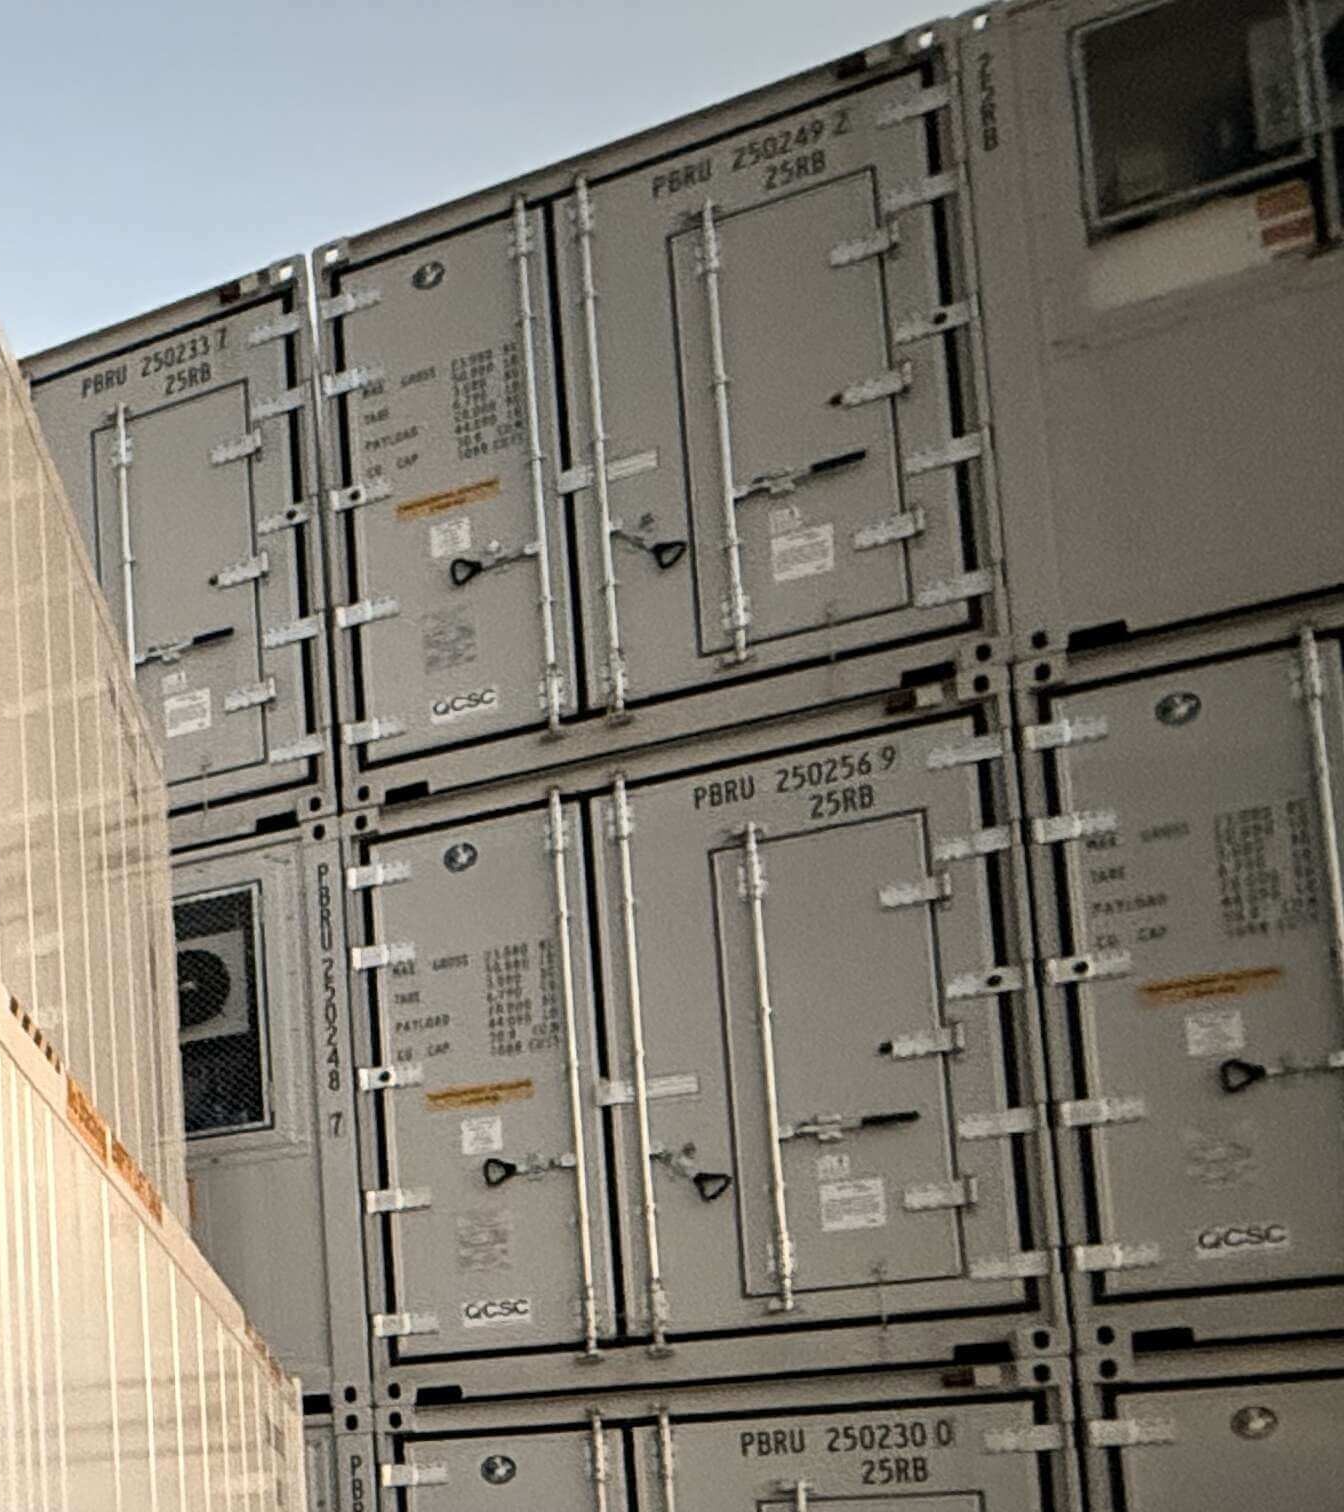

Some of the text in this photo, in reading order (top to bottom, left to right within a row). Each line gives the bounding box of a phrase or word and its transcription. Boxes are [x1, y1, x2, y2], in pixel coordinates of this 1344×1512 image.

[652, 165, 712, 198] PBRU
[732, 123, 824, 172] 250249
[763, 151, 826, 190] 25RB
[81, 365, 127, 398] PBRU
[141, 334, 211, 379] 250233
[165, 363, 211, 394] 25RB
[434, 688, 496, 718] QCSC
[693, 747, 896, 811] PBRU 250256 9
[810, 784, 874, 818] 25RB
[317, 864, 333, 949] PBRU
[321, 959, 339, 1092] 250248
[465, 1299, 530, 1321] QCSC
[740, 1421, 952, 1457] PBRU 250230 0
[862, 1457, 928, 1484] 25RB
